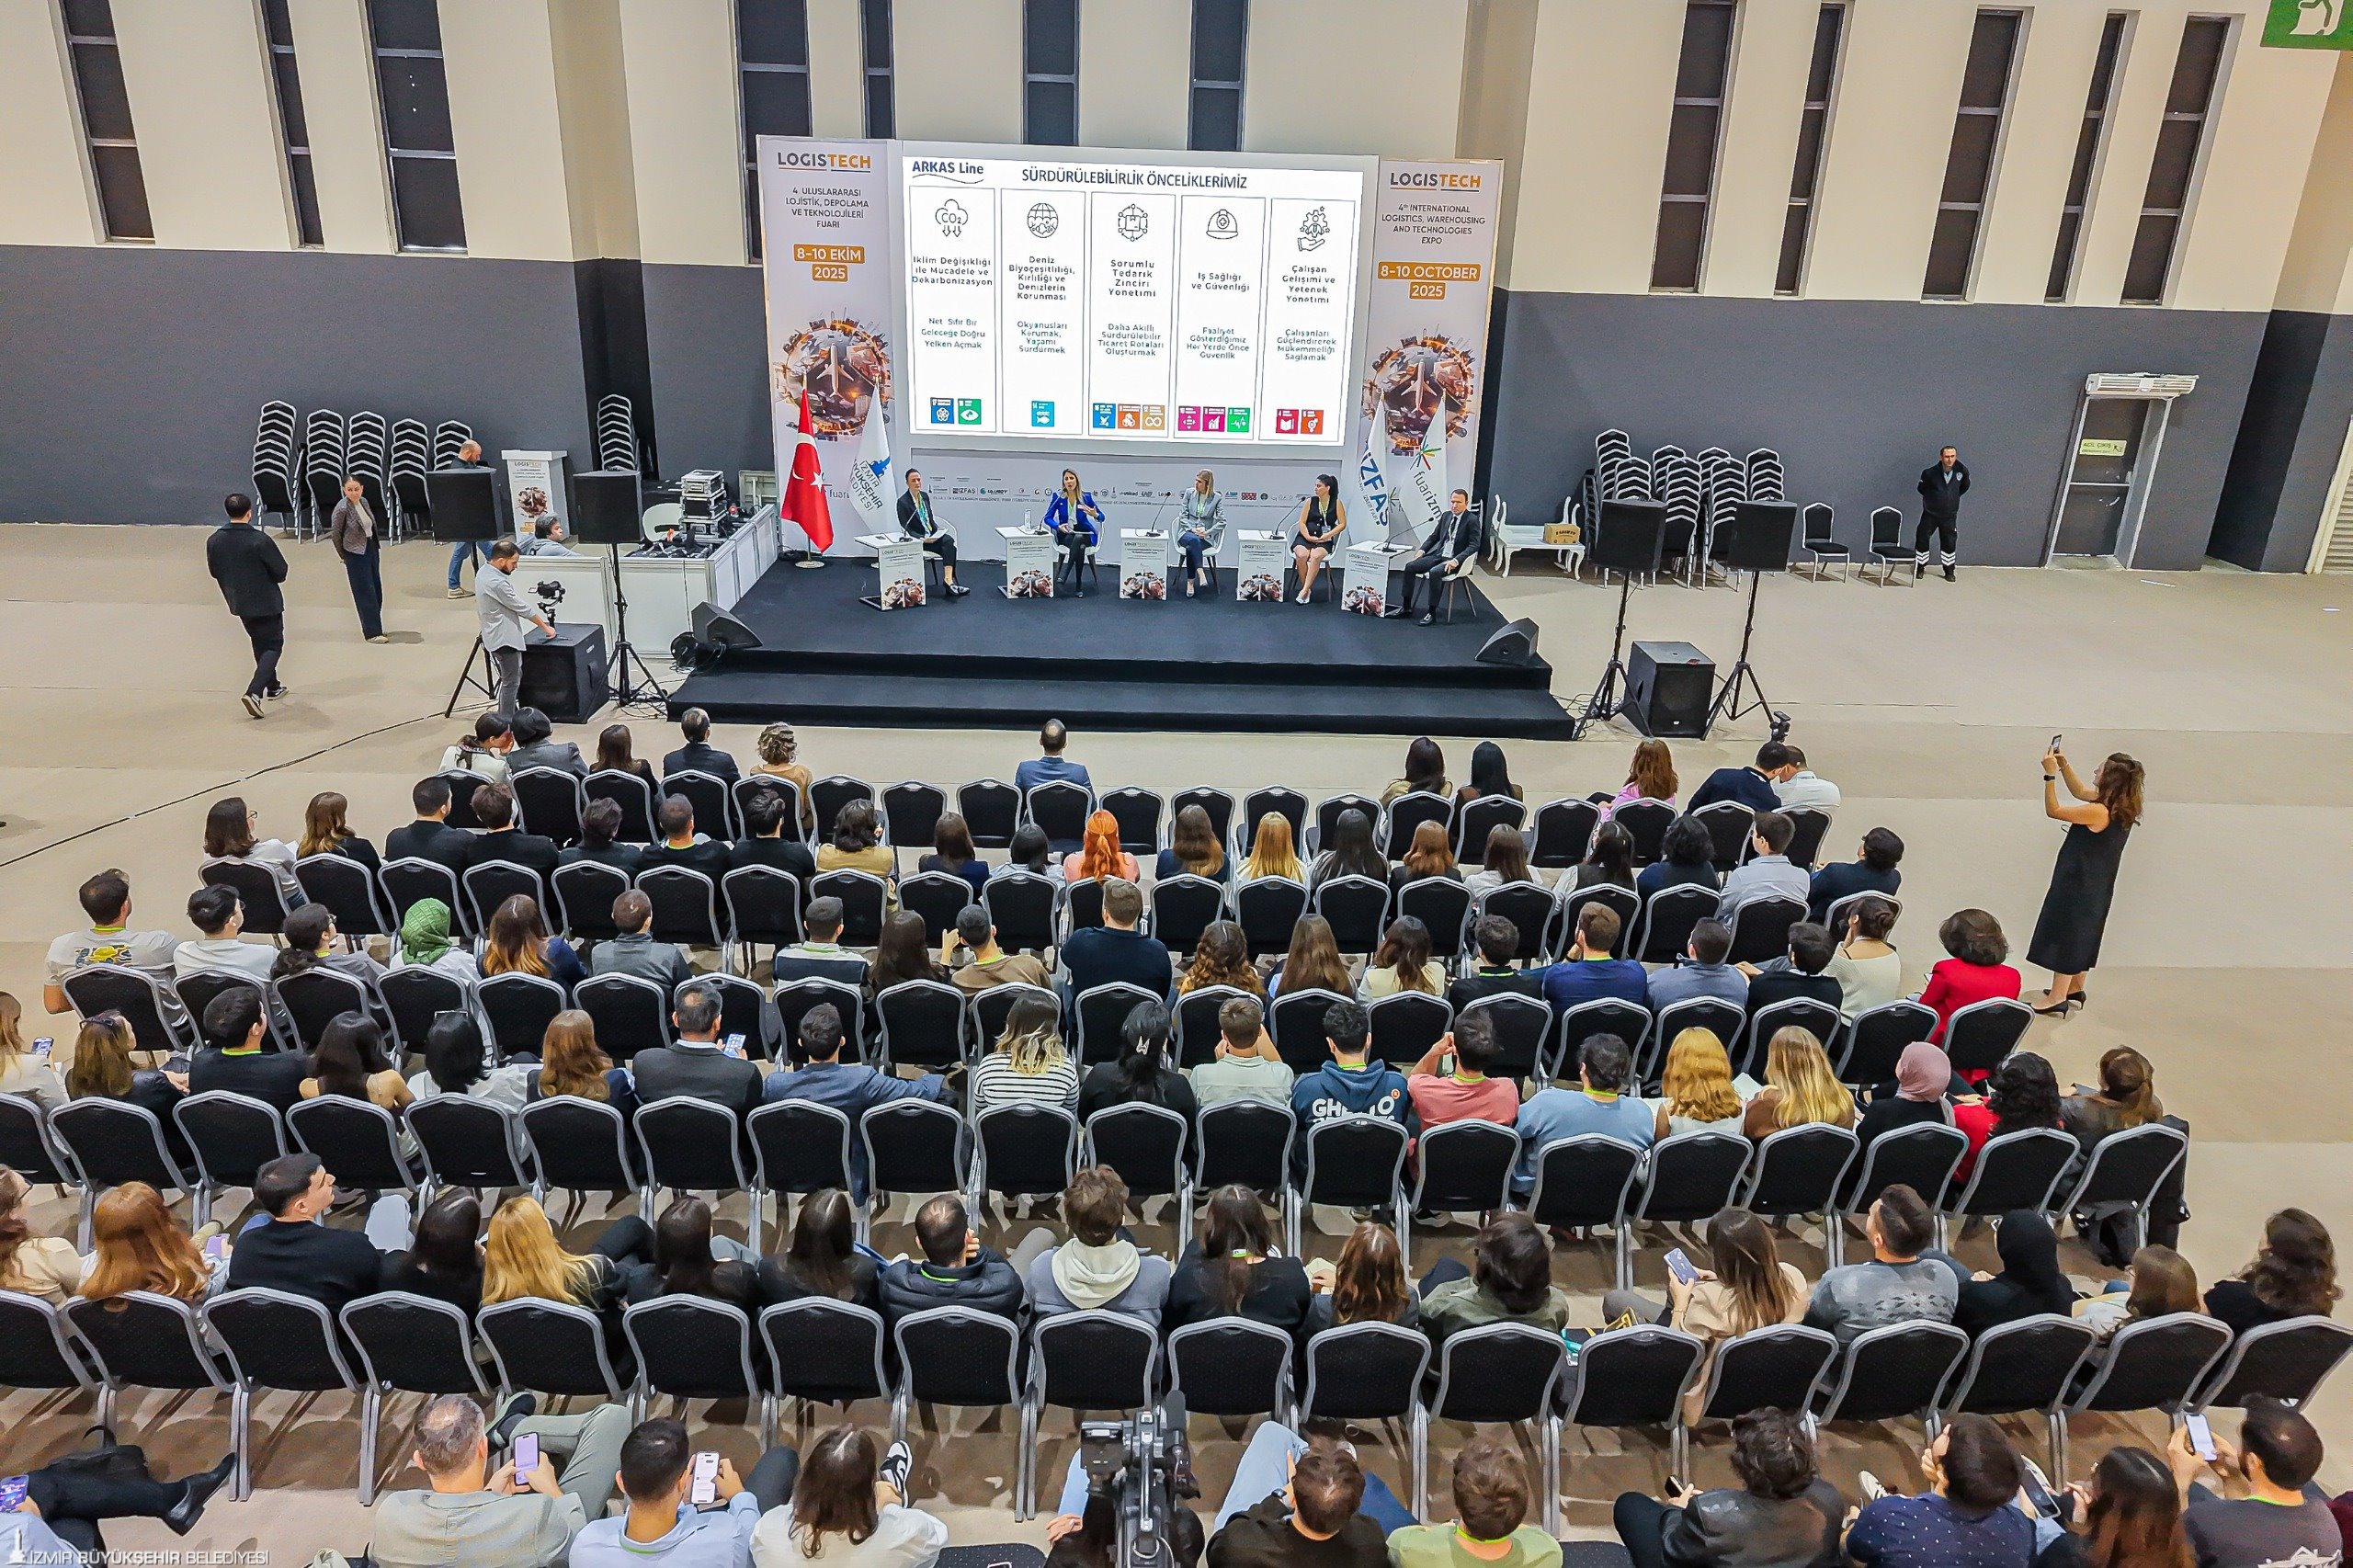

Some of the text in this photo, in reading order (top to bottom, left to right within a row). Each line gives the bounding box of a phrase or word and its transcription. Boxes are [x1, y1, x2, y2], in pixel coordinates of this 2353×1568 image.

[778, 152, 871, 168] LOGISTECH
[912, 161, 983, 174] ARKAS Line
[1022, 166, 1247, 189] SÜRDÜRÜLEBİLİRLİK ÖNCELİKLERİMİZ
[1390, 172, 1481, 188] LOGISTECH
[801, 187, 861, 197] ULUSLARARASI
[785, 197, 869, 208] LOJİSTİK, DEPOLAMA
[1410, 204, 1471, 212] INTERNATIONAL
[803, 209, 864, 219] TEKNOLOJİLERİ
[1381, 214, 1486, 224] LOGISTICS, WAREHOUSING
[1413, 225, 1472, 234] TECHNOLOGIES
[1421, 236, 1442, 244] EXPO
[797, 246, 861, 261] 8-10 EKİM
[1029, 256, 1055, 264] Deniz
[1110, 259, 1155, 268] Sorumlu
[813, 267, 846, 279] 2025
[1381, 265, 1477, 279] 8-10 OCTOBER
[1289, 285, 1328, 293] Yetenek
[1412, 285, 1443, 297] 2025
[1312, 1096, 1395, 1118] GHO
